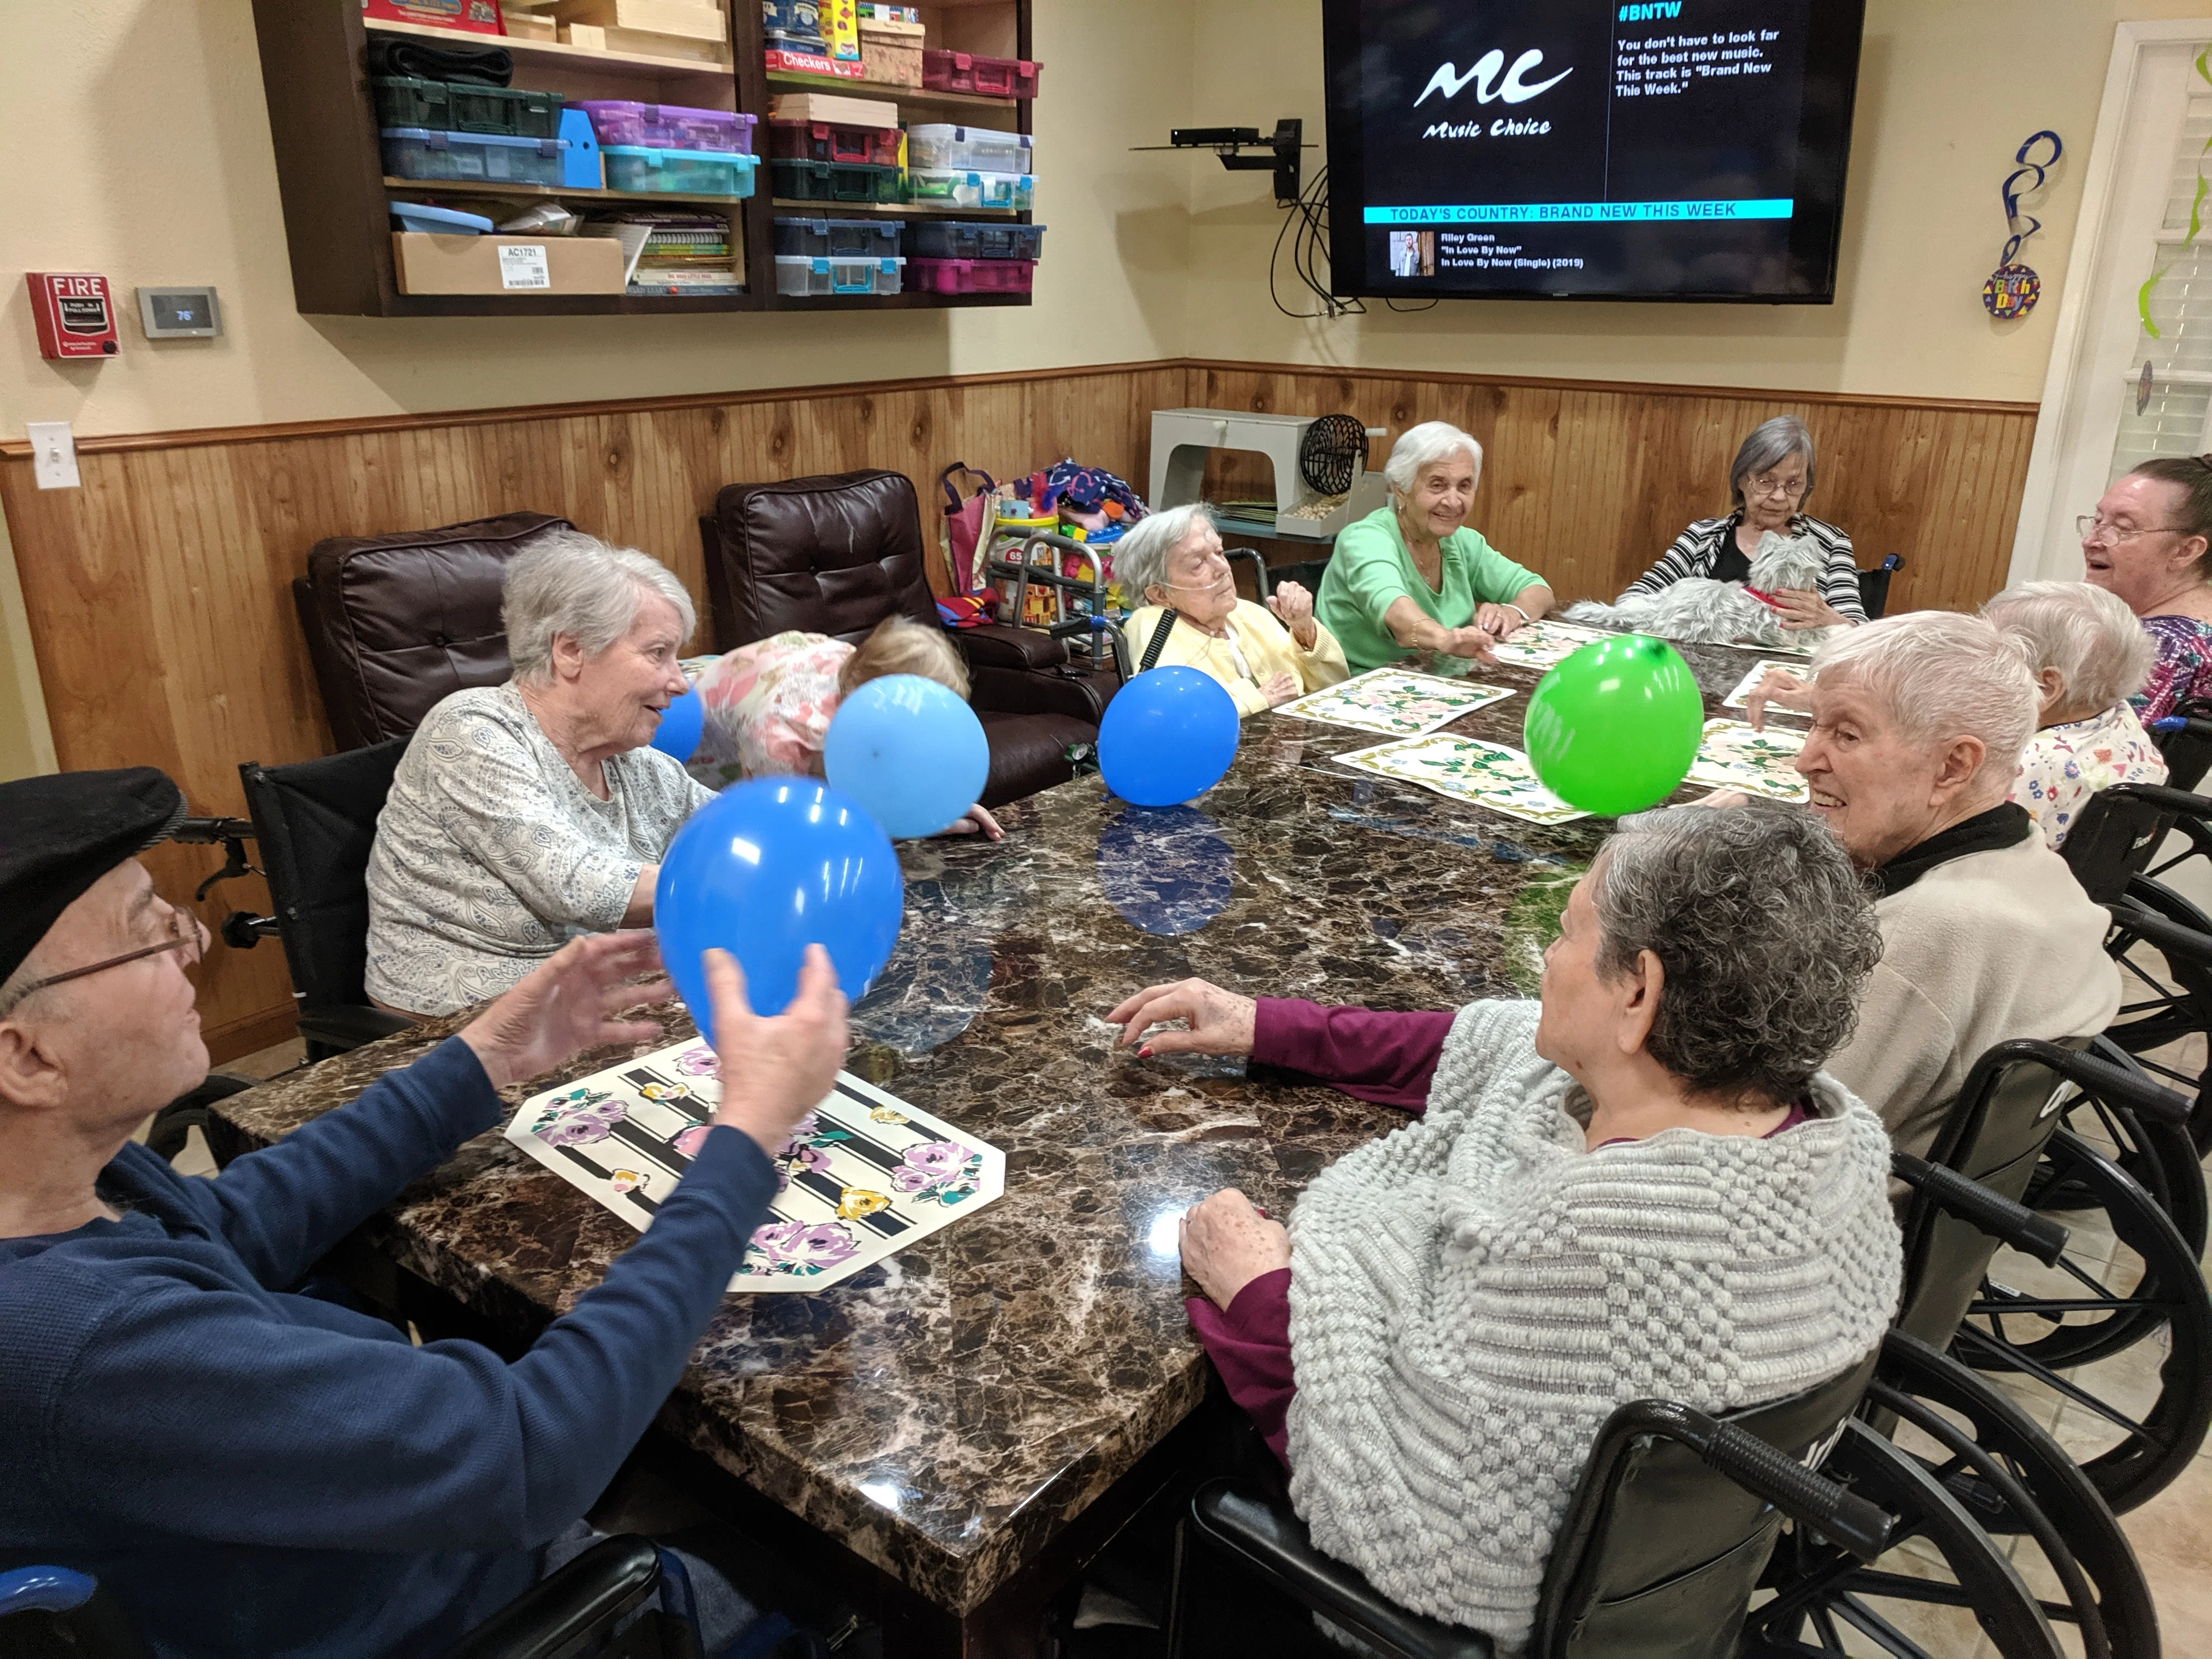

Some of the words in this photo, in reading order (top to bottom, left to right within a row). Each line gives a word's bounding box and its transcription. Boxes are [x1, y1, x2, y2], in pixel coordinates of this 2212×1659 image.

[1619, 1, 1682, 22] #BNTW
[1617, 39, 1641, 51] You
[1644, 37, 1675, 50] don't
[1678, 35, 1708, 47] have
[1712, 33, 1725, 45] to
[1728, 30, 1756, 43] look
[1760, 29, 1780, 42] far
[783, 52, 831, 71] Checkers
[1617, 54, 1635, 67] for
[1638, 52, 1658, 65] the
[1661, 51, 1689, 64] best
[1692, 50, 1719, 62] new
[1721, 45, 1763, 60] music.
[1616, 69, 1641, 81] This
[1645, 67, 1677, 80] track
[1681, 66, 1692, 78] is
[1696, 63, 1740, 77] "Brand
[1743, 62, 1772, 74] New
[1615, 84, 1641, 97] This
[1644, 81, 1689, 96] Week."
[1422, 120, 1482, 139] Music
[1490, 117, 1552, 137] Choice
[1390, 208, 1451, 220] TODAY'S
[1539, 205, 1593, 219] BRAND
[1600, 204, 1637, 218] NEW
[1643, 203, 1680, 217] THIS
[1686, 203, 1737, 216] WEEK
[1441, 233, 1464, 244] Riley
[1467, 233, 1496, 242] Green
[508, 248, 537, 256] AC1721
[1441, 245, 1455, 255] "In
[1456, 245, 1479, 255] Love
[1481, 245, 1494, 256] By
[1496, 245, 1522, 255] Now"
[1441, 258, 1450, 267] In
[1452, 258, 1474, 267] Love
[1476, 258, 1489, 268] By
[1491, 258, 1512, 267] Now
[1514, 258, 1551, 269] (Single)
[1552, 258, 1584, 269] (2019)
[53, 278, 104, 296] FIRE
[1009, 551, 1023, 561] 65
